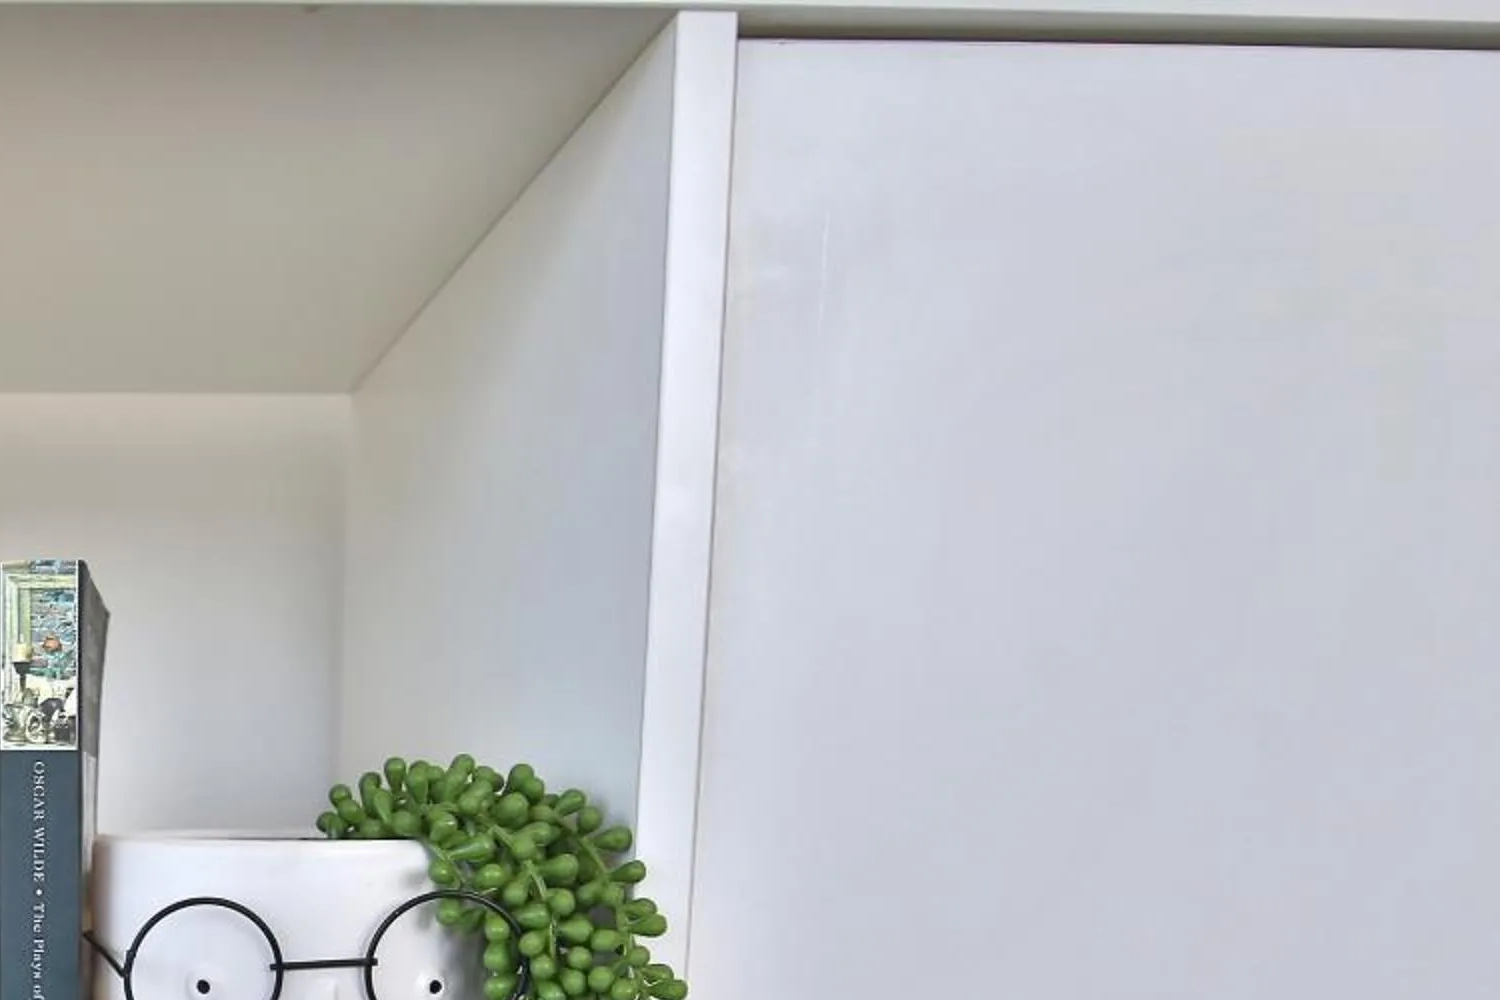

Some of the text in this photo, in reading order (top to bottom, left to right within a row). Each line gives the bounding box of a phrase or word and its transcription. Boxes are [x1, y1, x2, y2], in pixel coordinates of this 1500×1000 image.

[32, 761, 45, 820] OSCAR
[32, 827, 45, 882] WILDE
[32, 904, 45, 932] The
[30, 938, 45, 979] Plays
[32, 985, 45, 1000] of
